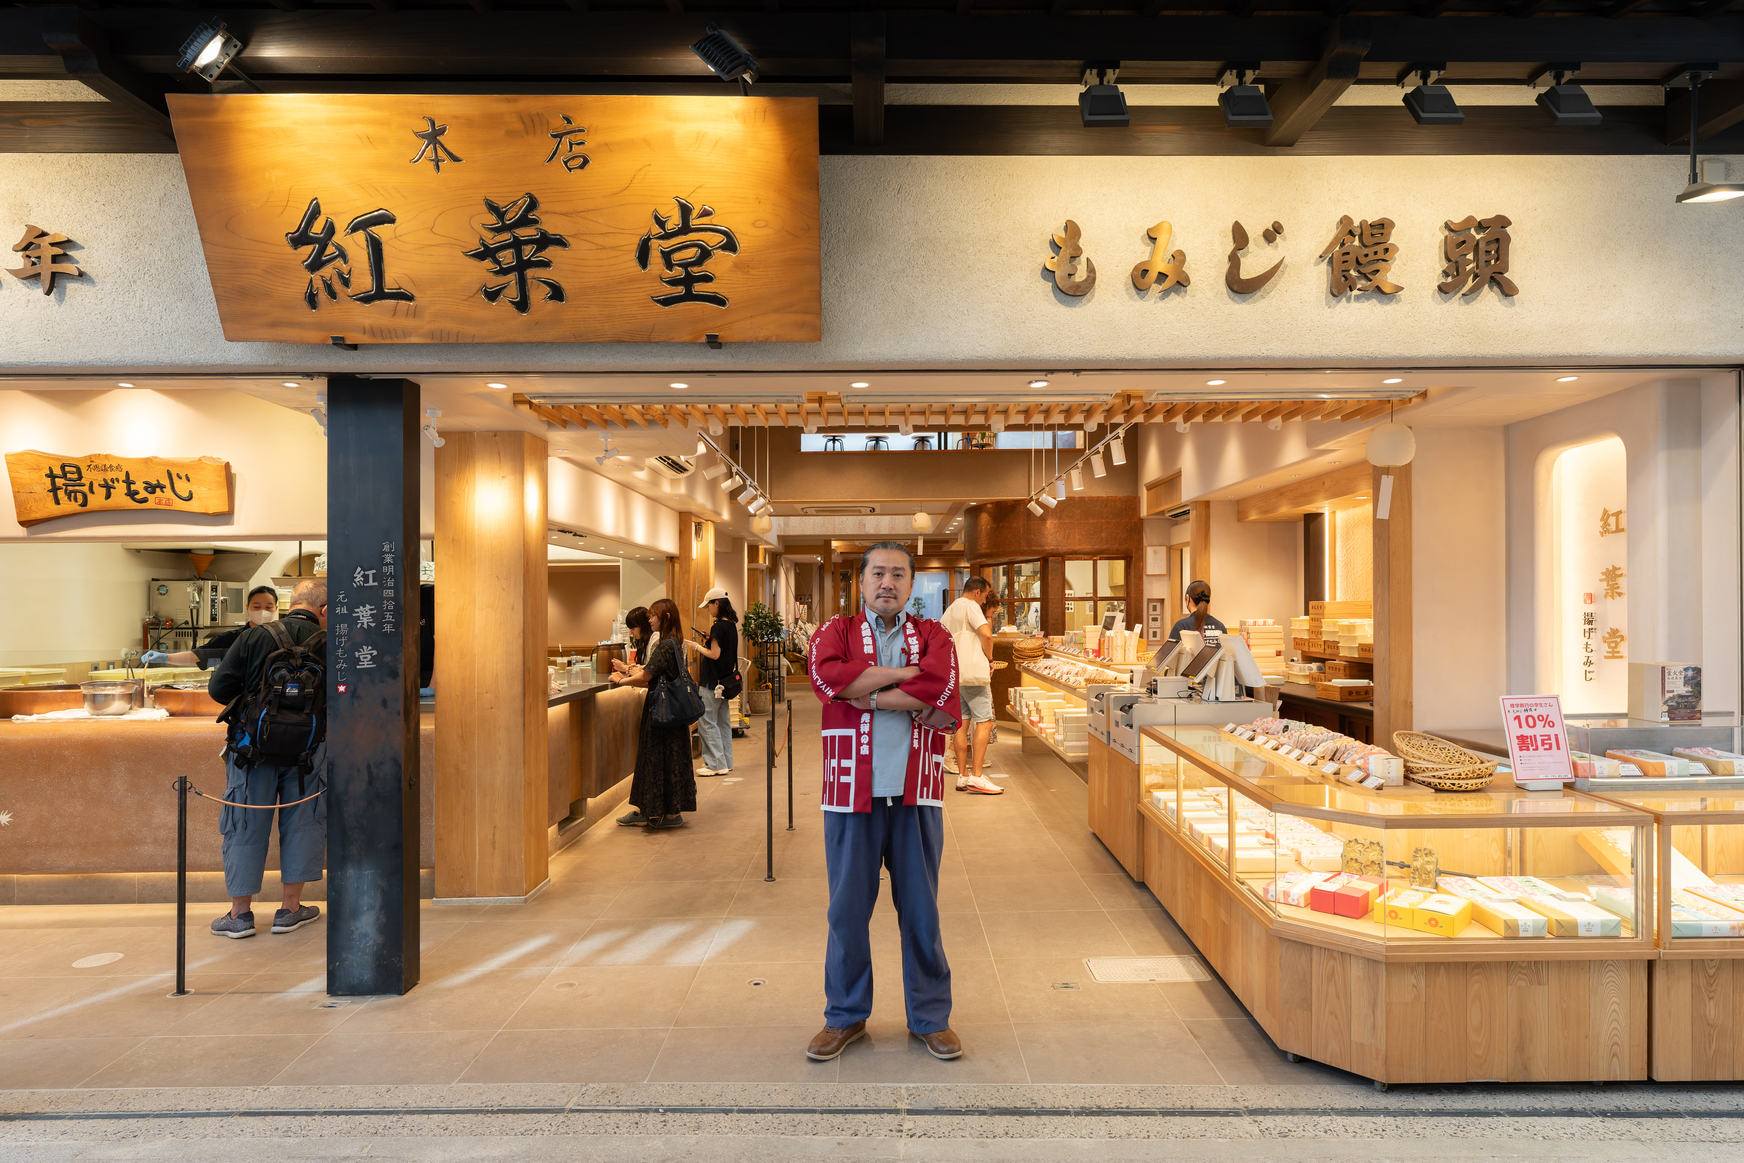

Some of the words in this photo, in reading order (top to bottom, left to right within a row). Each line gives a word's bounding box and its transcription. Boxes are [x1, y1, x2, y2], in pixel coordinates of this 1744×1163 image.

[409, 112, 592, 175] 本店
[285, 192, 742, 317] 紅葉堂
[1043, 213, 1520, 298] もみじ饅頭
[45, 462, 194, 508] 揚げもみじ
[335, 590, 349, 615] 元祖
[381, 541, 396, 634] 創業明治四拾五年
[1598, 507, 1627, 660] 紅葉堂
[351, 566, 379, 670] 紅葉堂
[1582, 612, 1597, 682] 揚げもみじ
[335, 623, 349, 683] 揚げもみじ
[936, 668, 956, 707] MOMIJIDO
[1513, 714, 1555, 729] 10%
[1516, 733, 1561, 752] 割引
